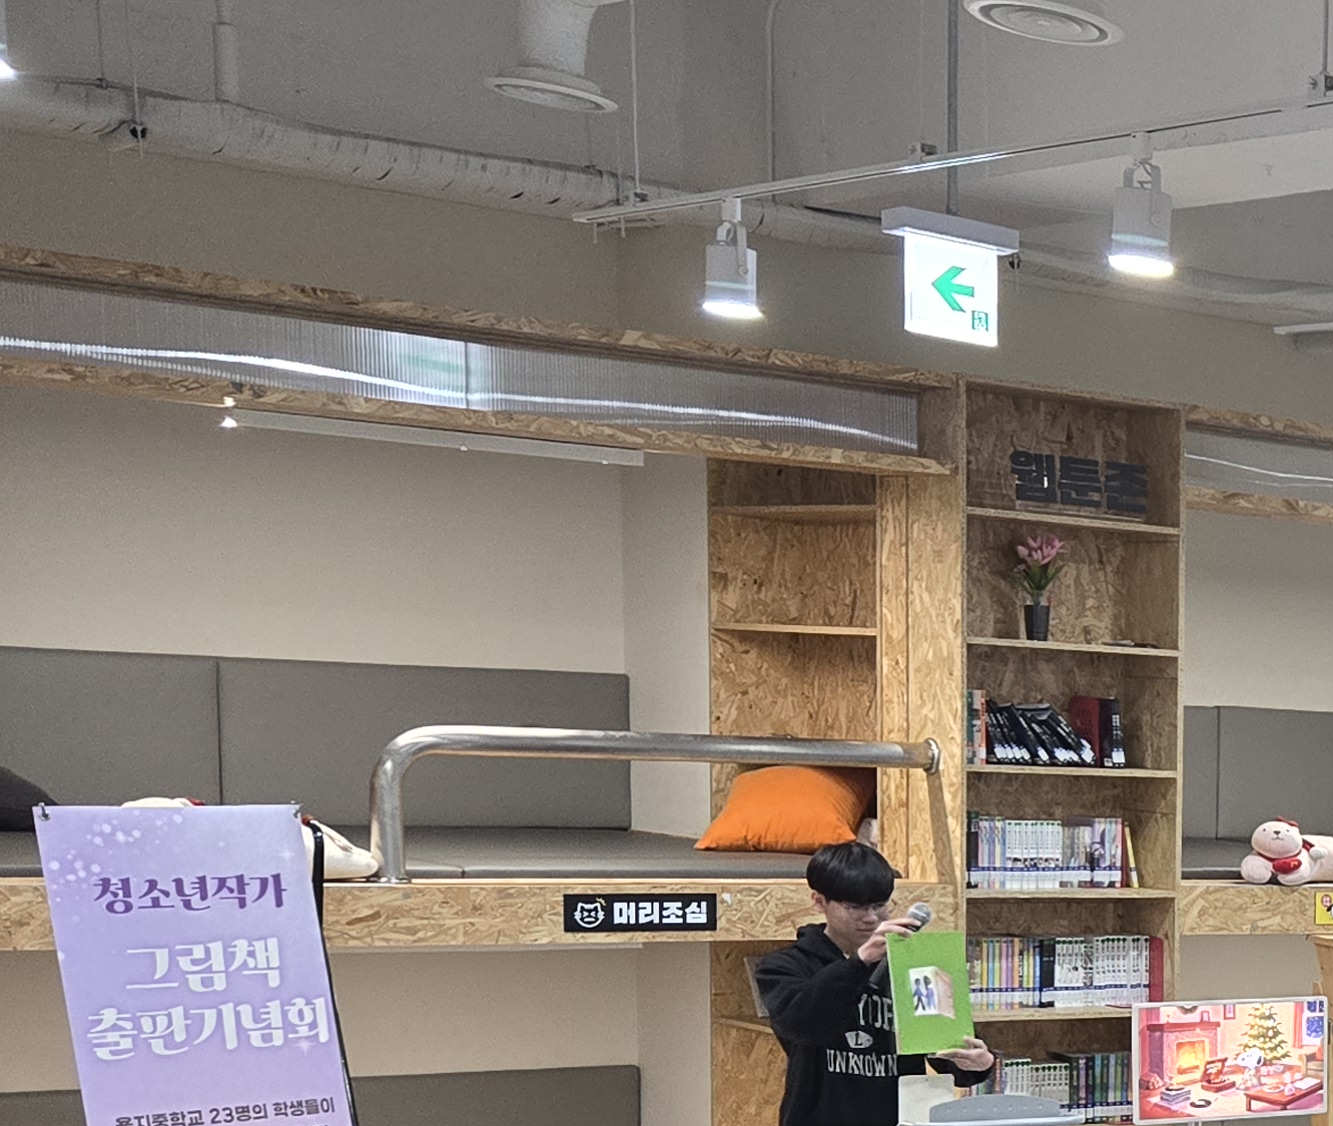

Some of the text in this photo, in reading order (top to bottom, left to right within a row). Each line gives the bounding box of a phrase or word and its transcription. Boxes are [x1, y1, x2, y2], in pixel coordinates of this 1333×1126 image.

[1010, 450, 1147, 513] 웹툰존
[92, 874, 287, 914] 청소년작가
[613, 901, 708, 925] 머리조심
[126, 936, 281, 993] 그림책
[87, 996, 331, 1060] 출판기념회
[826, 1048, 898, 1077] UNKNOWN
[209, 1103, 268, 1126] 23명의
[272, 1097, 336, 1119] 학생들이
